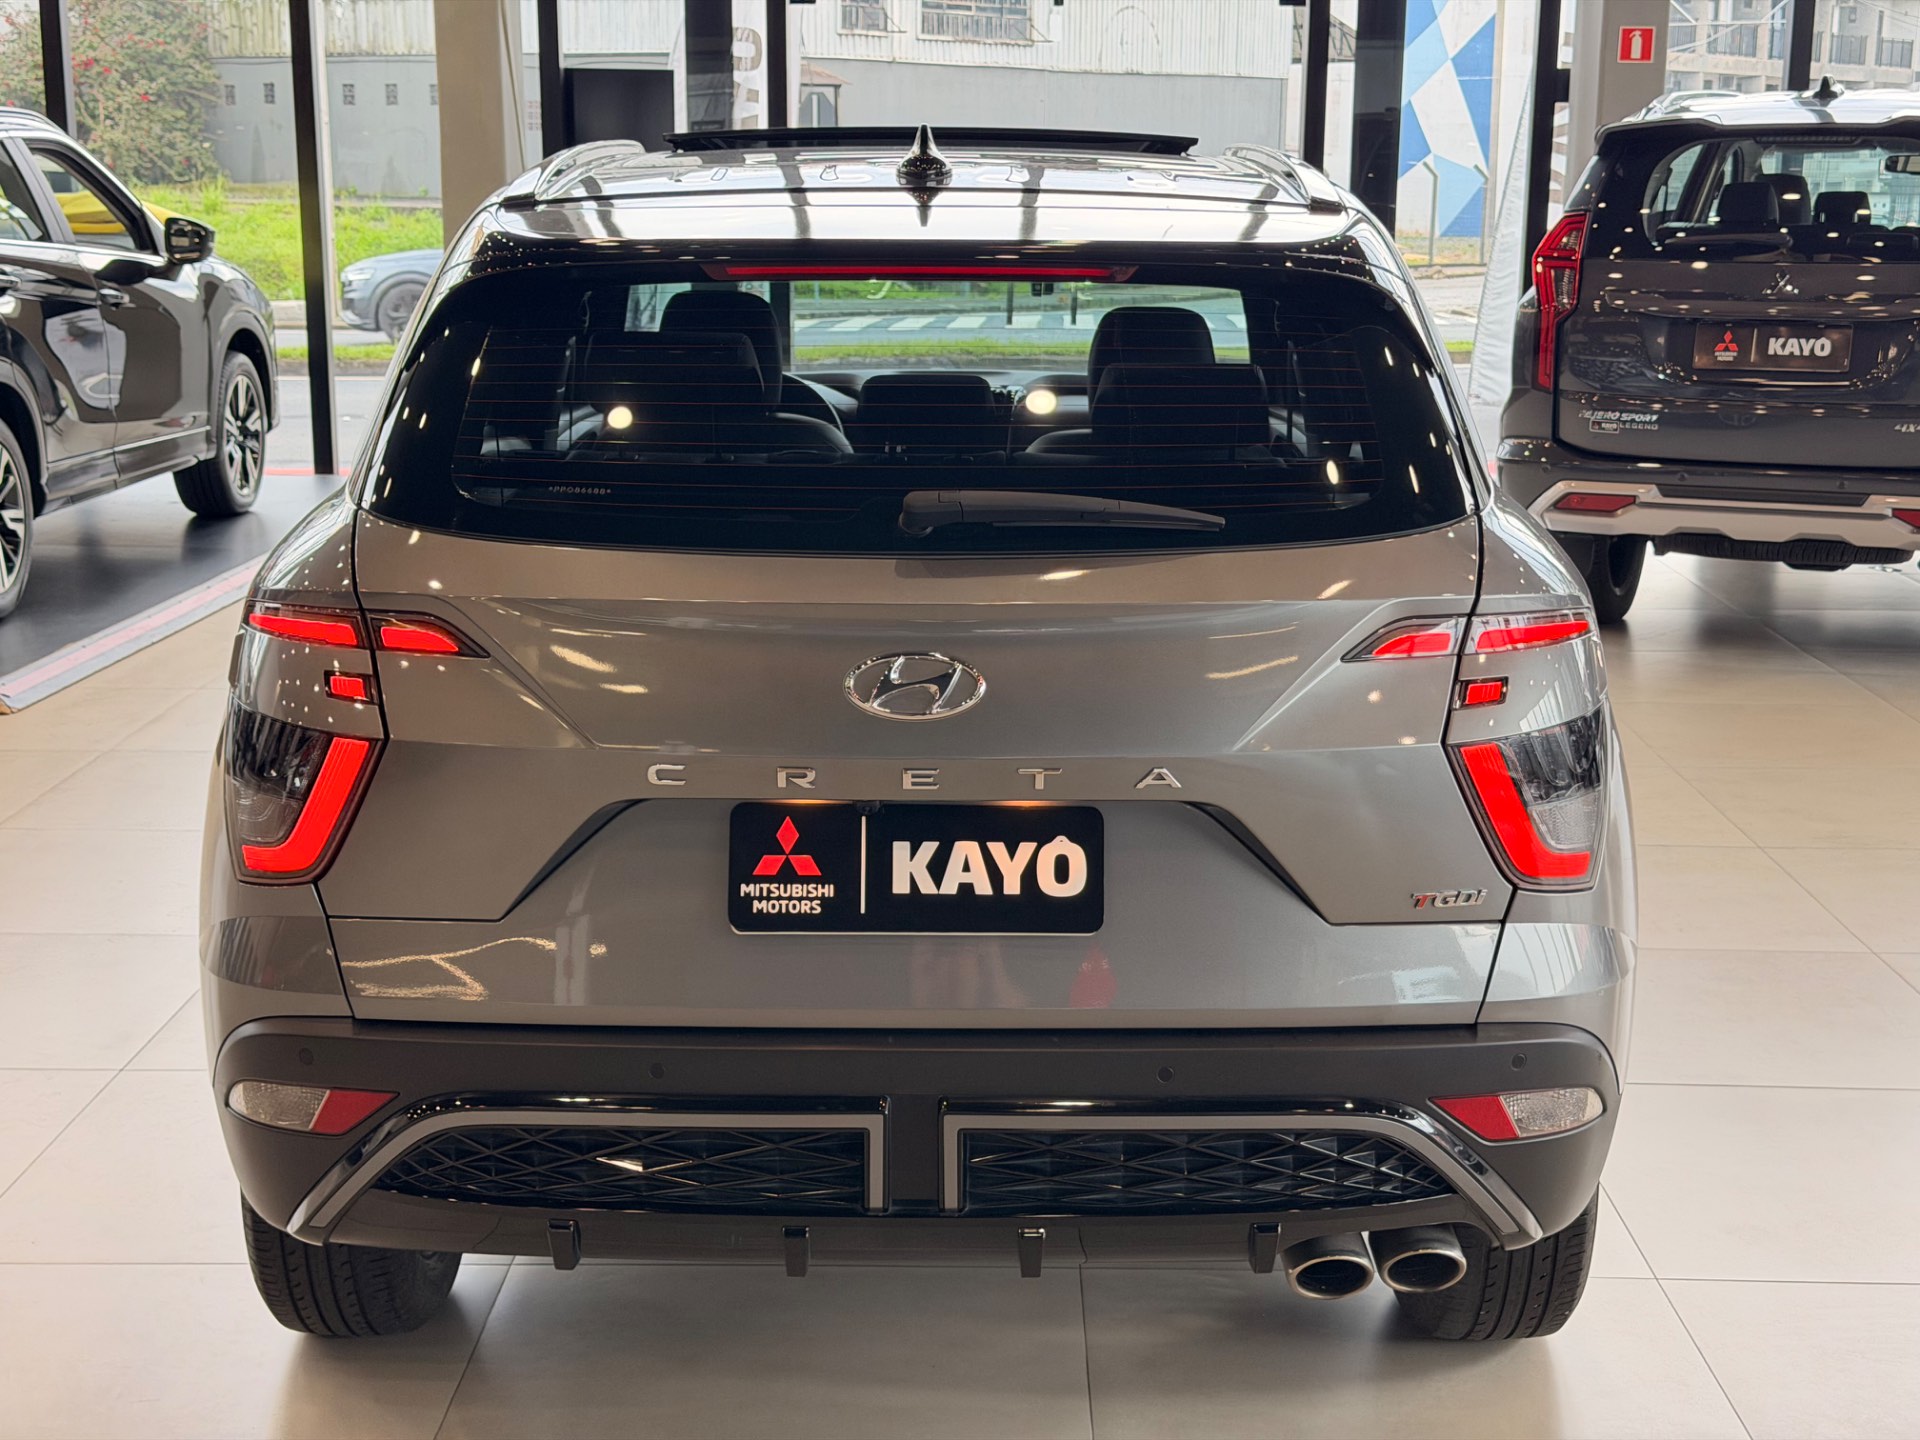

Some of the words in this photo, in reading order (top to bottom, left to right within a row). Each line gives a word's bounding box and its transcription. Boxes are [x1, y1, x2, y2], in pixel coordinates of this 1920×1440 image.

[1620, 412, 1659, 422] SPORT
[1619, 421, 1659, 431] LEGEND
[647, 763, 1182, 789] CRETA
[892, 835, 1088, 898] KAYÔ
[740, 883, 835, 898] MITSUBISHI
[752, 899, 822, 915] MOTORS
